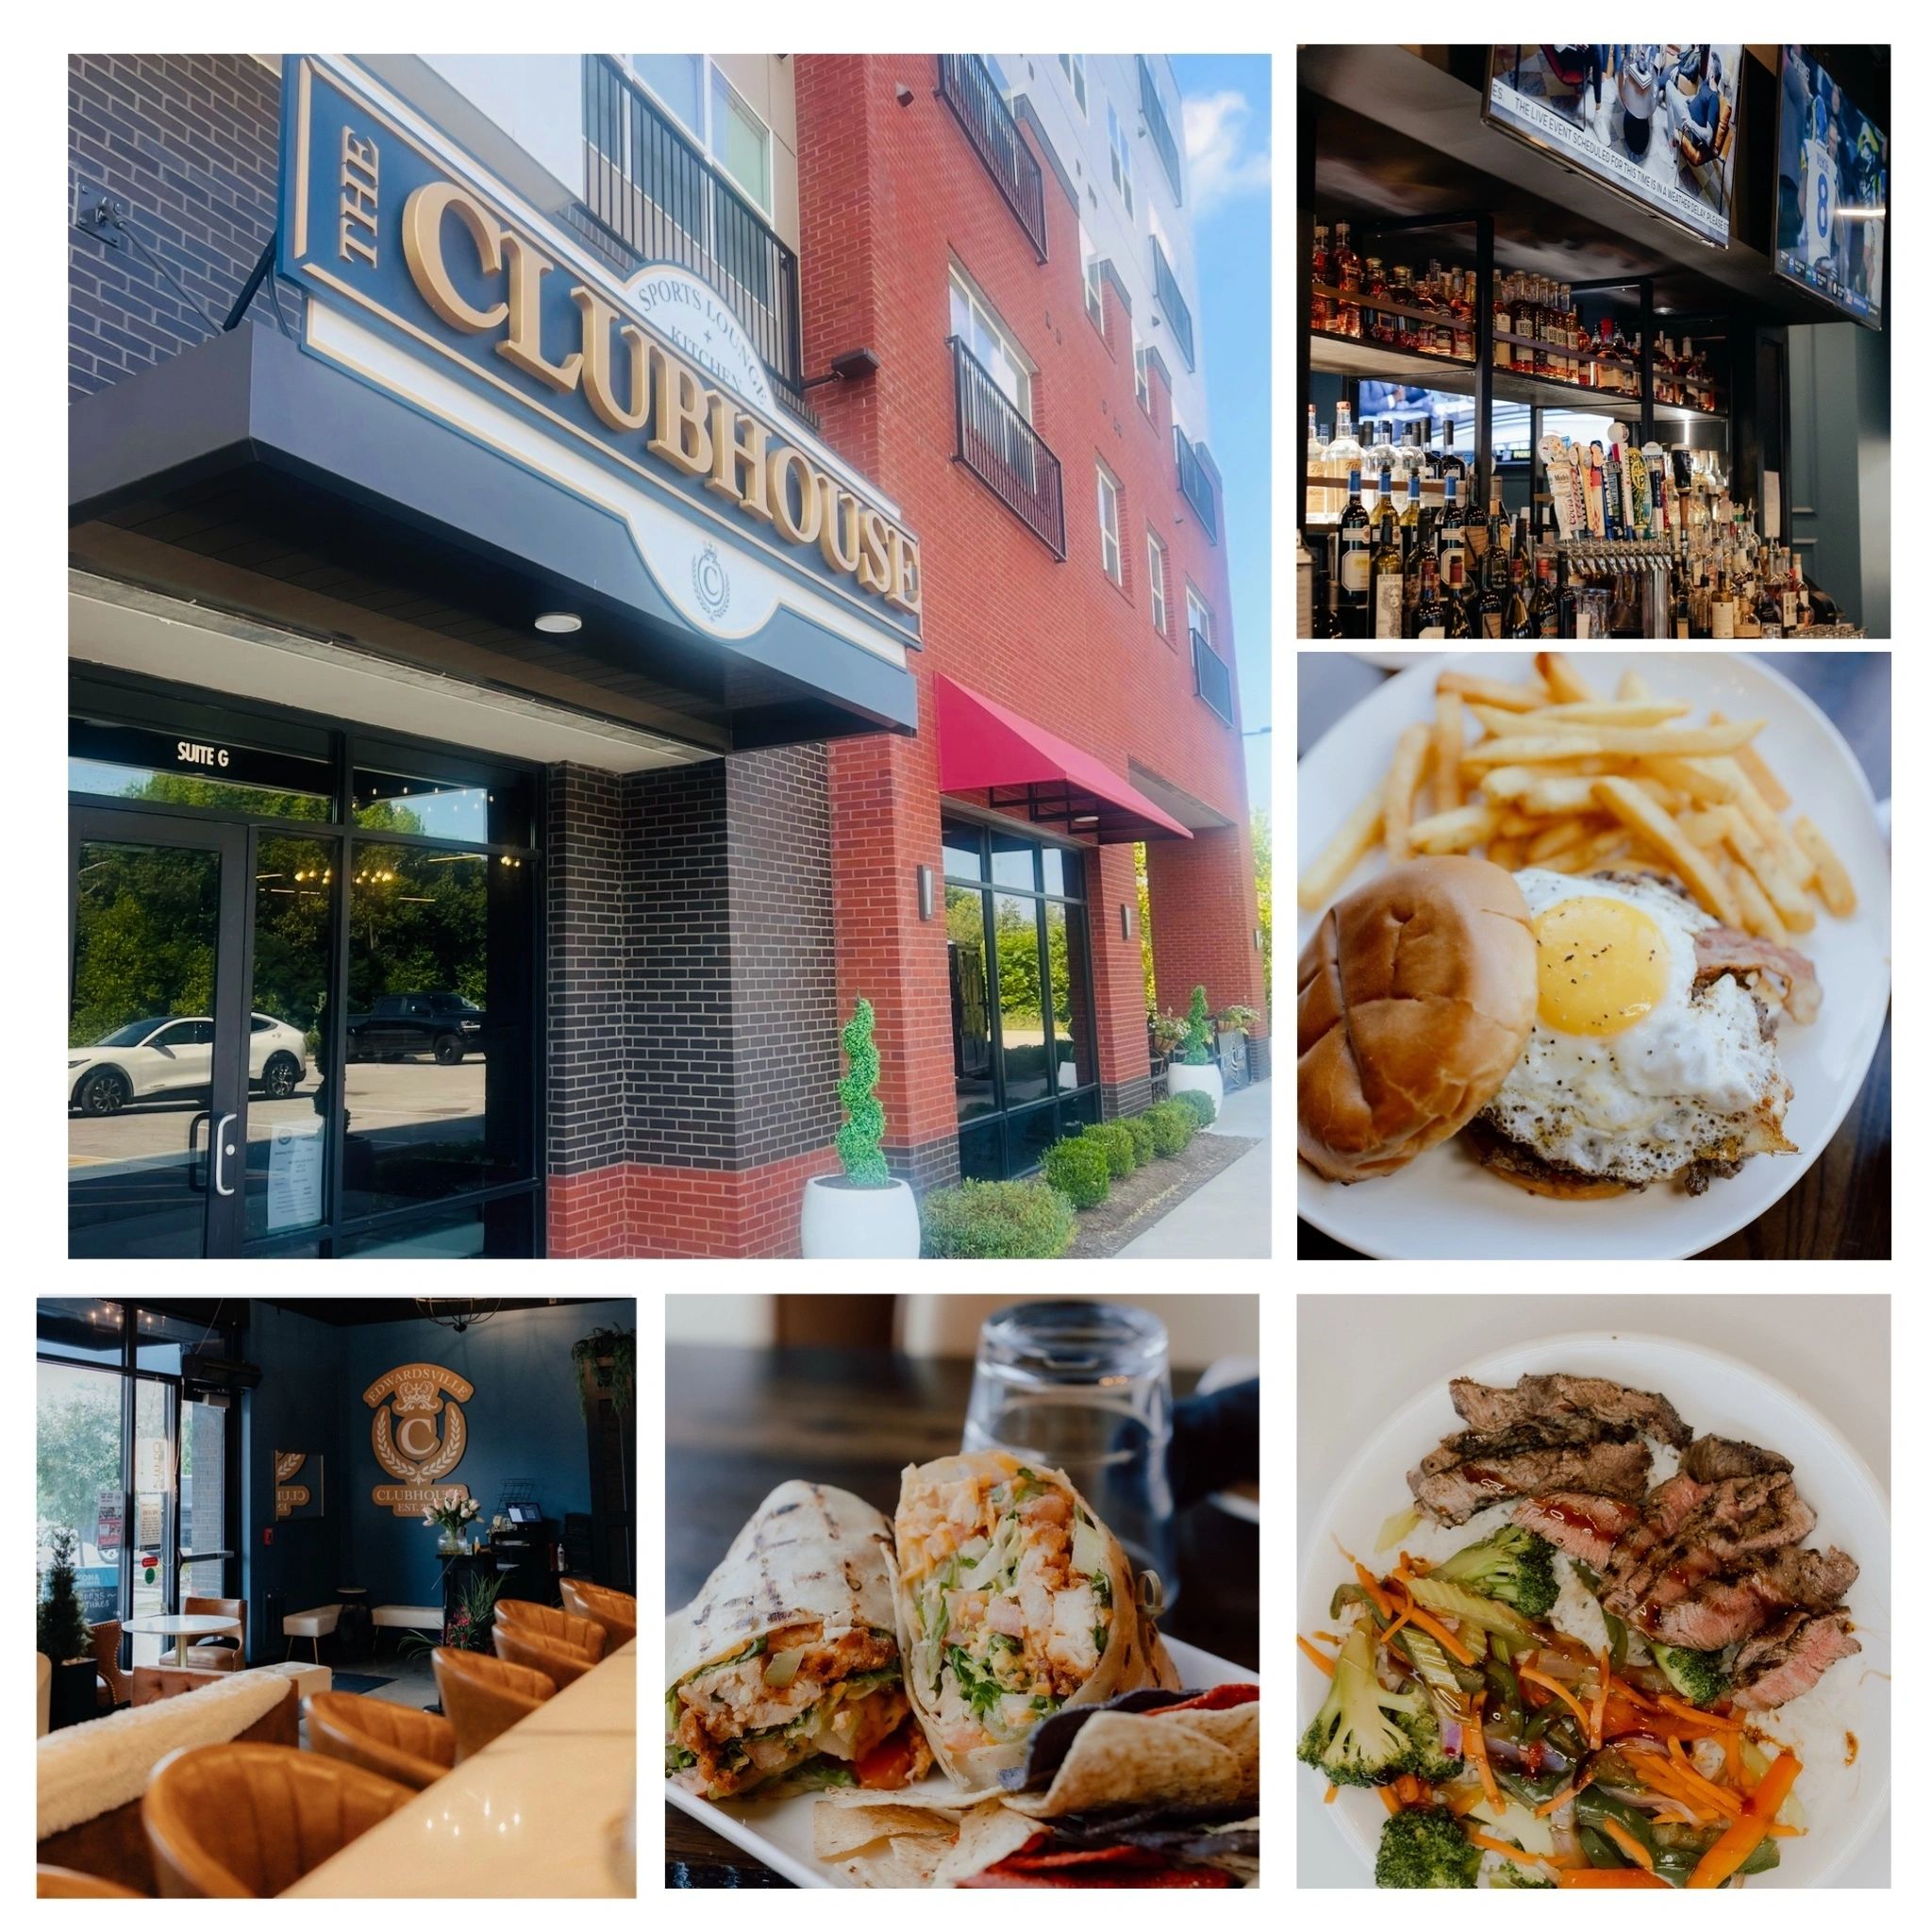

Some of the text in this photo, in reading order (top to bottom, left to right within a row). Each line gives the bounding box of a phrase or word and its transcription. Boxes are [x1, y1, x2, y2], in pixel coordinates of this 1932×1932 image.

[1515, 97, 1530, 116] THE
[1531, 107, 1549, 127] LIVE
[1549, 116, 1572, 139] EVENT
[1573, 132, 1610, 163] SCHEDULED
[1610, 155, 1624, 171] FOR
[1624, 163, 1638, 179] THIS
[1637, 171, 1651, 188] TIME
[1650, 177, 1657, 191] IS
[1657, 182, 1663, 194] IN
[1662, 187, 1668, 197] A
[1667, 189, 1690, 210] WEATHER
[1690, 202, 1706, 220] DELAY
[1706, 212, 1724, 229] PLEASE
[340, 125, 379, 270] THE
[1817, 172, 1828, 239] 8
[638, 280, 768, 406] SPORTS LOUNGE
[671, 325, 742, 394] KITCHEN
[402, 181, 922, 616] CLUBHOUSE
[704, 566, 719, 596] C
[177, 741, 229, 767] SUITE G
[368, 1368, 469, 1403] EDWARDSVILLE
[401, 1418, 436, 1456] C
[376, 1490, 451, 1502] CLUBHOU
